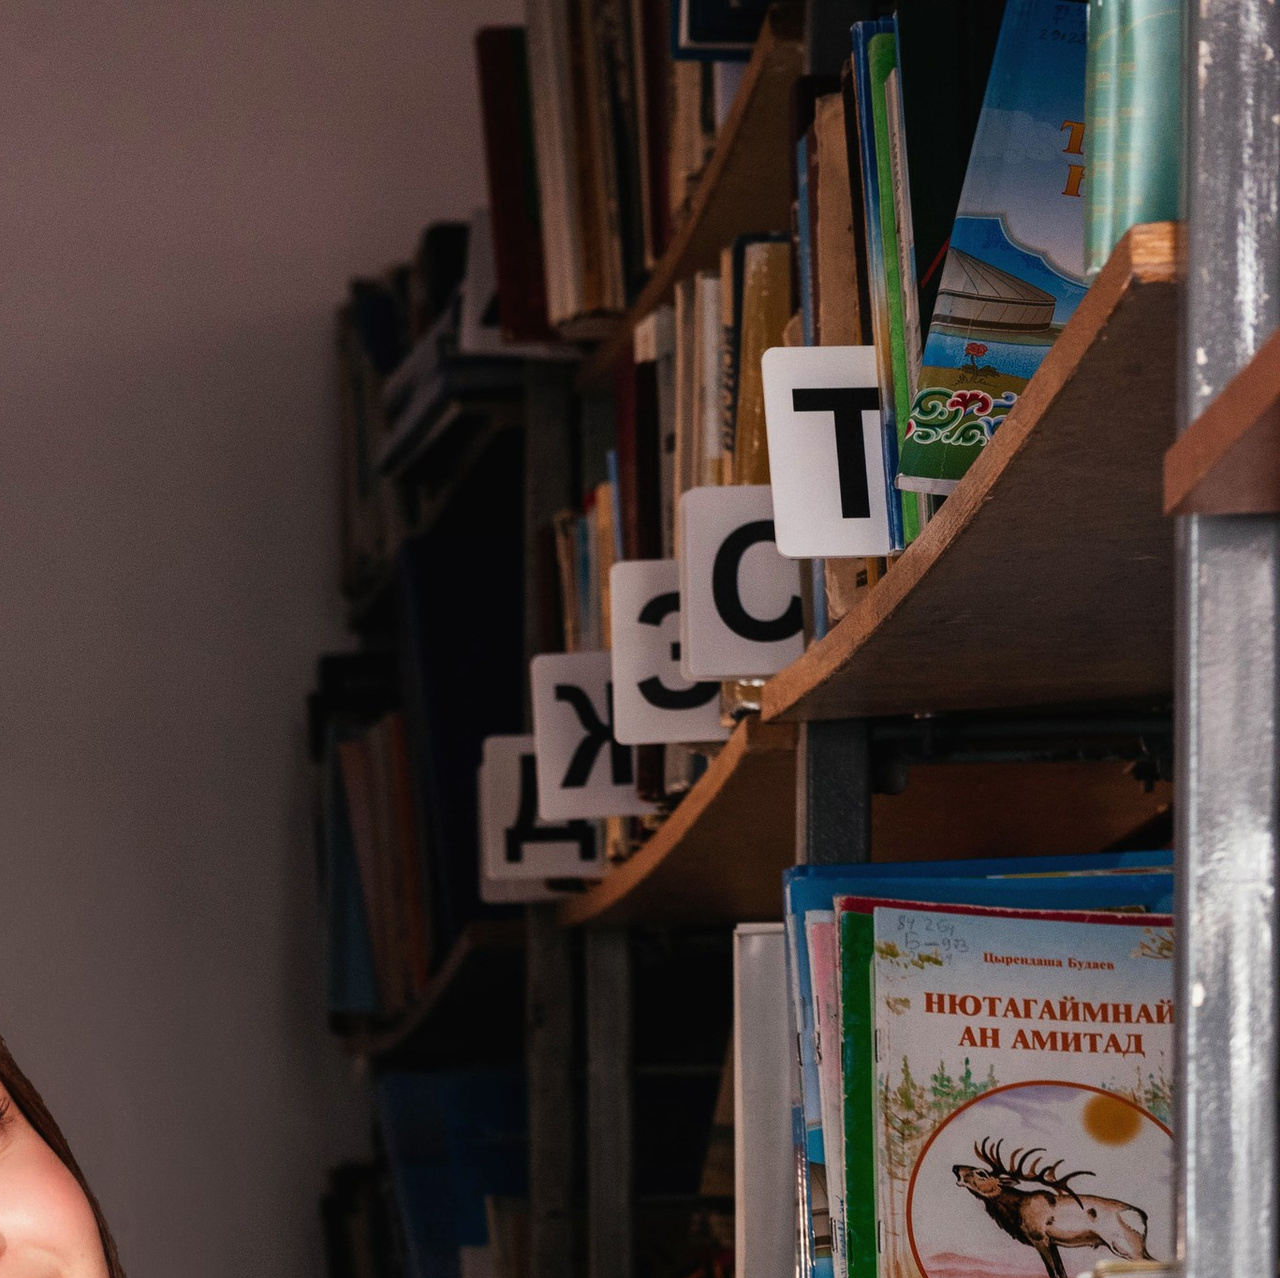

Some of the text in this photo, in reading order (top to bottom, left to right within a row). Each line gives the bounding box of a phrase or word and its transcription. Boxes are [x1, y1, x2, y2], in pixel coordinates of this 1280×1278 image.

[793, 387, 880, 519] Т
[712, 519, 804, 642] С
[983, 952, 1115, 972] Цырендаша Будаев
[924, 992, 1174, 1024] НЮТАГАЙМНАЙ
[958, 1026, 1146, 1058] АН АМИТАД
